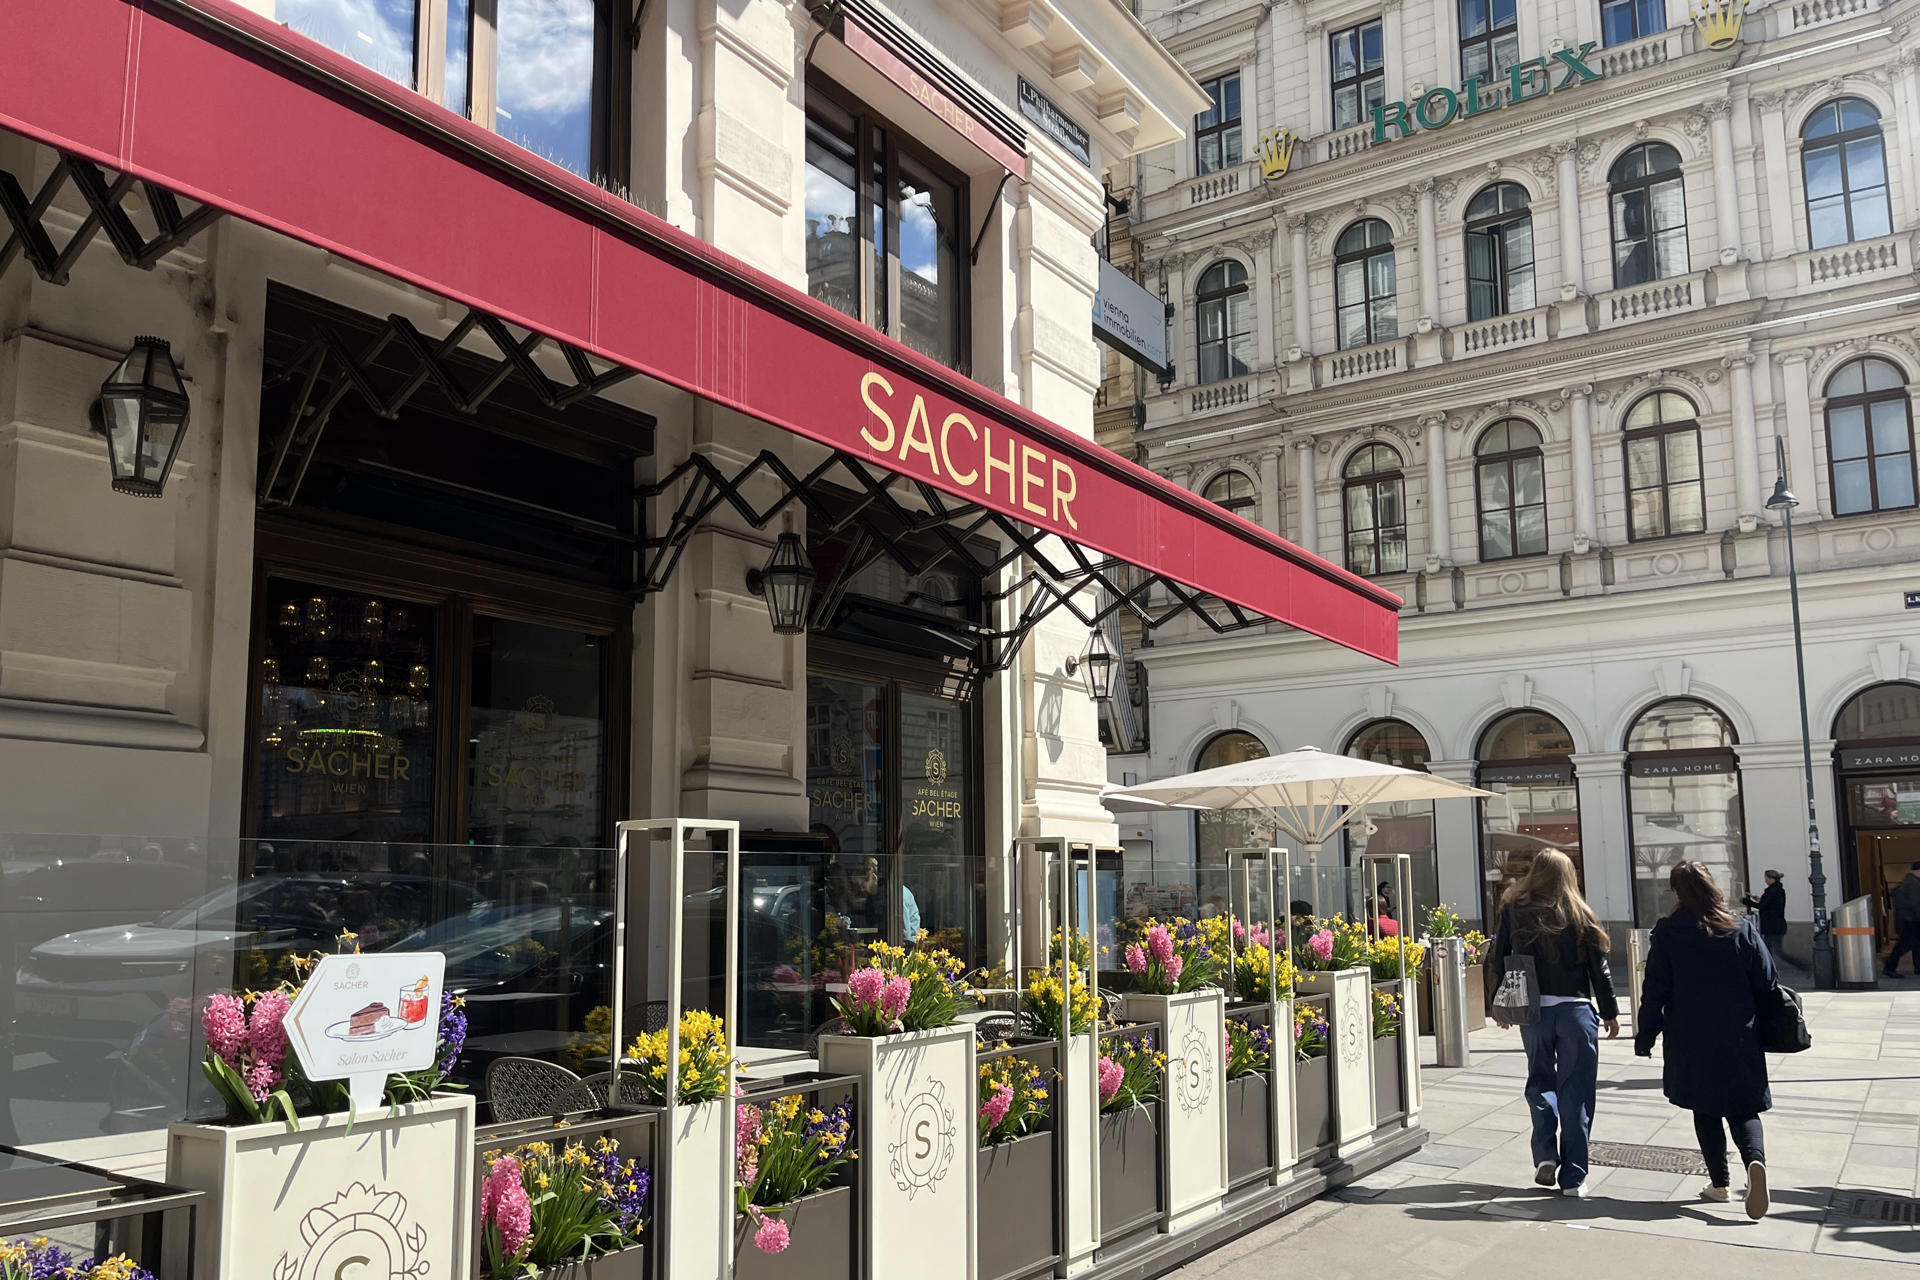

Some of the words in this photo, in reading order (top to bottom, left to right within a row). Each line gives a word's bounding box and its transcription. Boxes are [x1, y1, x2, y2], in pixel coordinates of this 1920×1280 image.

[1369, 40, 1603, 147] ROLEX
[910, 73, 975, 140] SACHER
[1103, 298, 1129, 323] vienna
[860, 372, 1078, 531] SACHER
[286, 747, 410, 781] SACHER
[933, 762, 939, 775] S
[1643, 766, 1678, 774] ZARA
[1684, 763, 1722, 772] HOME
[1855, 756, 1893, 765] ZARA
[332, 783, 367, 794] WIEN
[930, 789, 940, 797] BEL
[812, 789, 873, 811] SACHER
[911, 799, 961, 819] SACHER
[929, 820, 944, 828] WIEN
[333, 980, 369, 991] SACHER
[1348, 1023, 1356, 1046] S
[337, 1051, 368, 1066] Salon
[370, 1048, 408, 1063] Sacher
[1190, 1060, 1200, 1088] S
[915, 1120, 931, 1159] S
